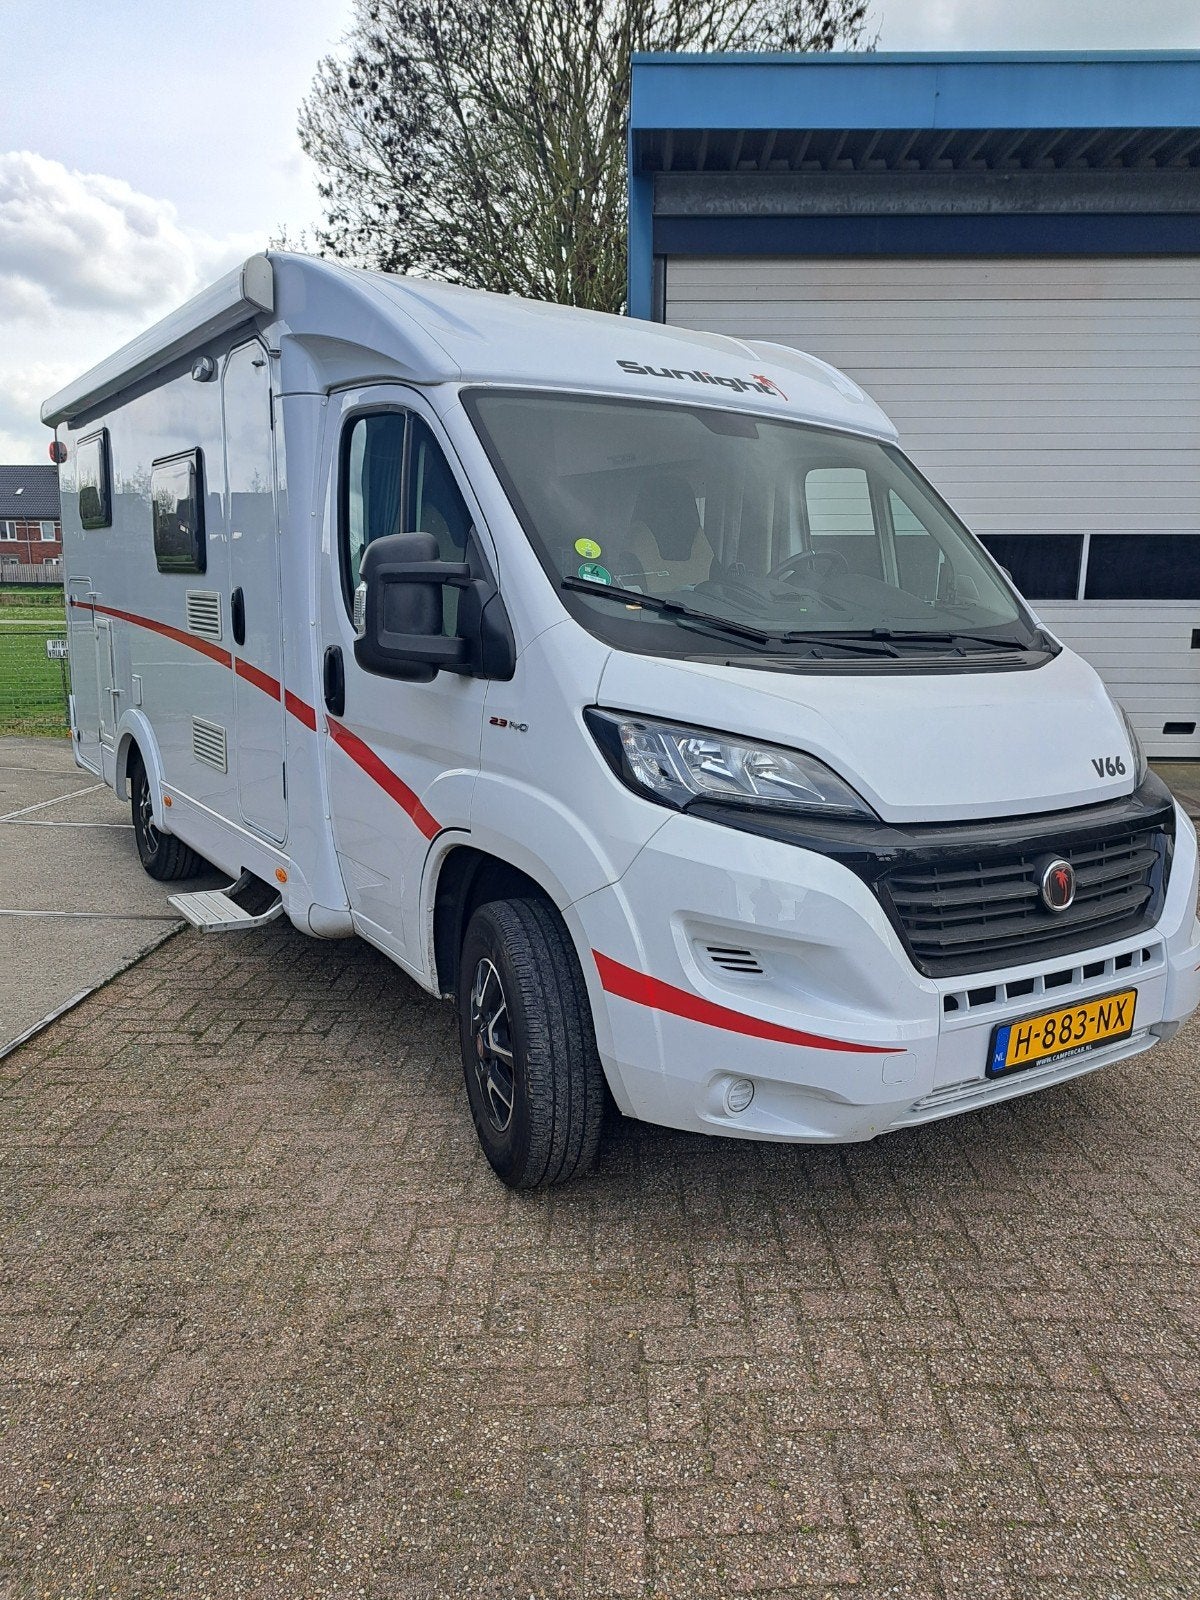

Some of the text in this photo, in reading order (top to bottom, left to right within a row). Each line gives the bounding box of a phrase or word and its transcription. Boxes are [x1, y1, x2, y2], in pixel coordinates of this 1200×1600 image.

[616, 359, 777, 397] Sunlight
[591, 566, 600, 577] 4
[1091, 756, 1126, 778] V66
[1014, 998, 1128, 1059] H-883-NX
[994, 1052, 1005, 1063] NL
